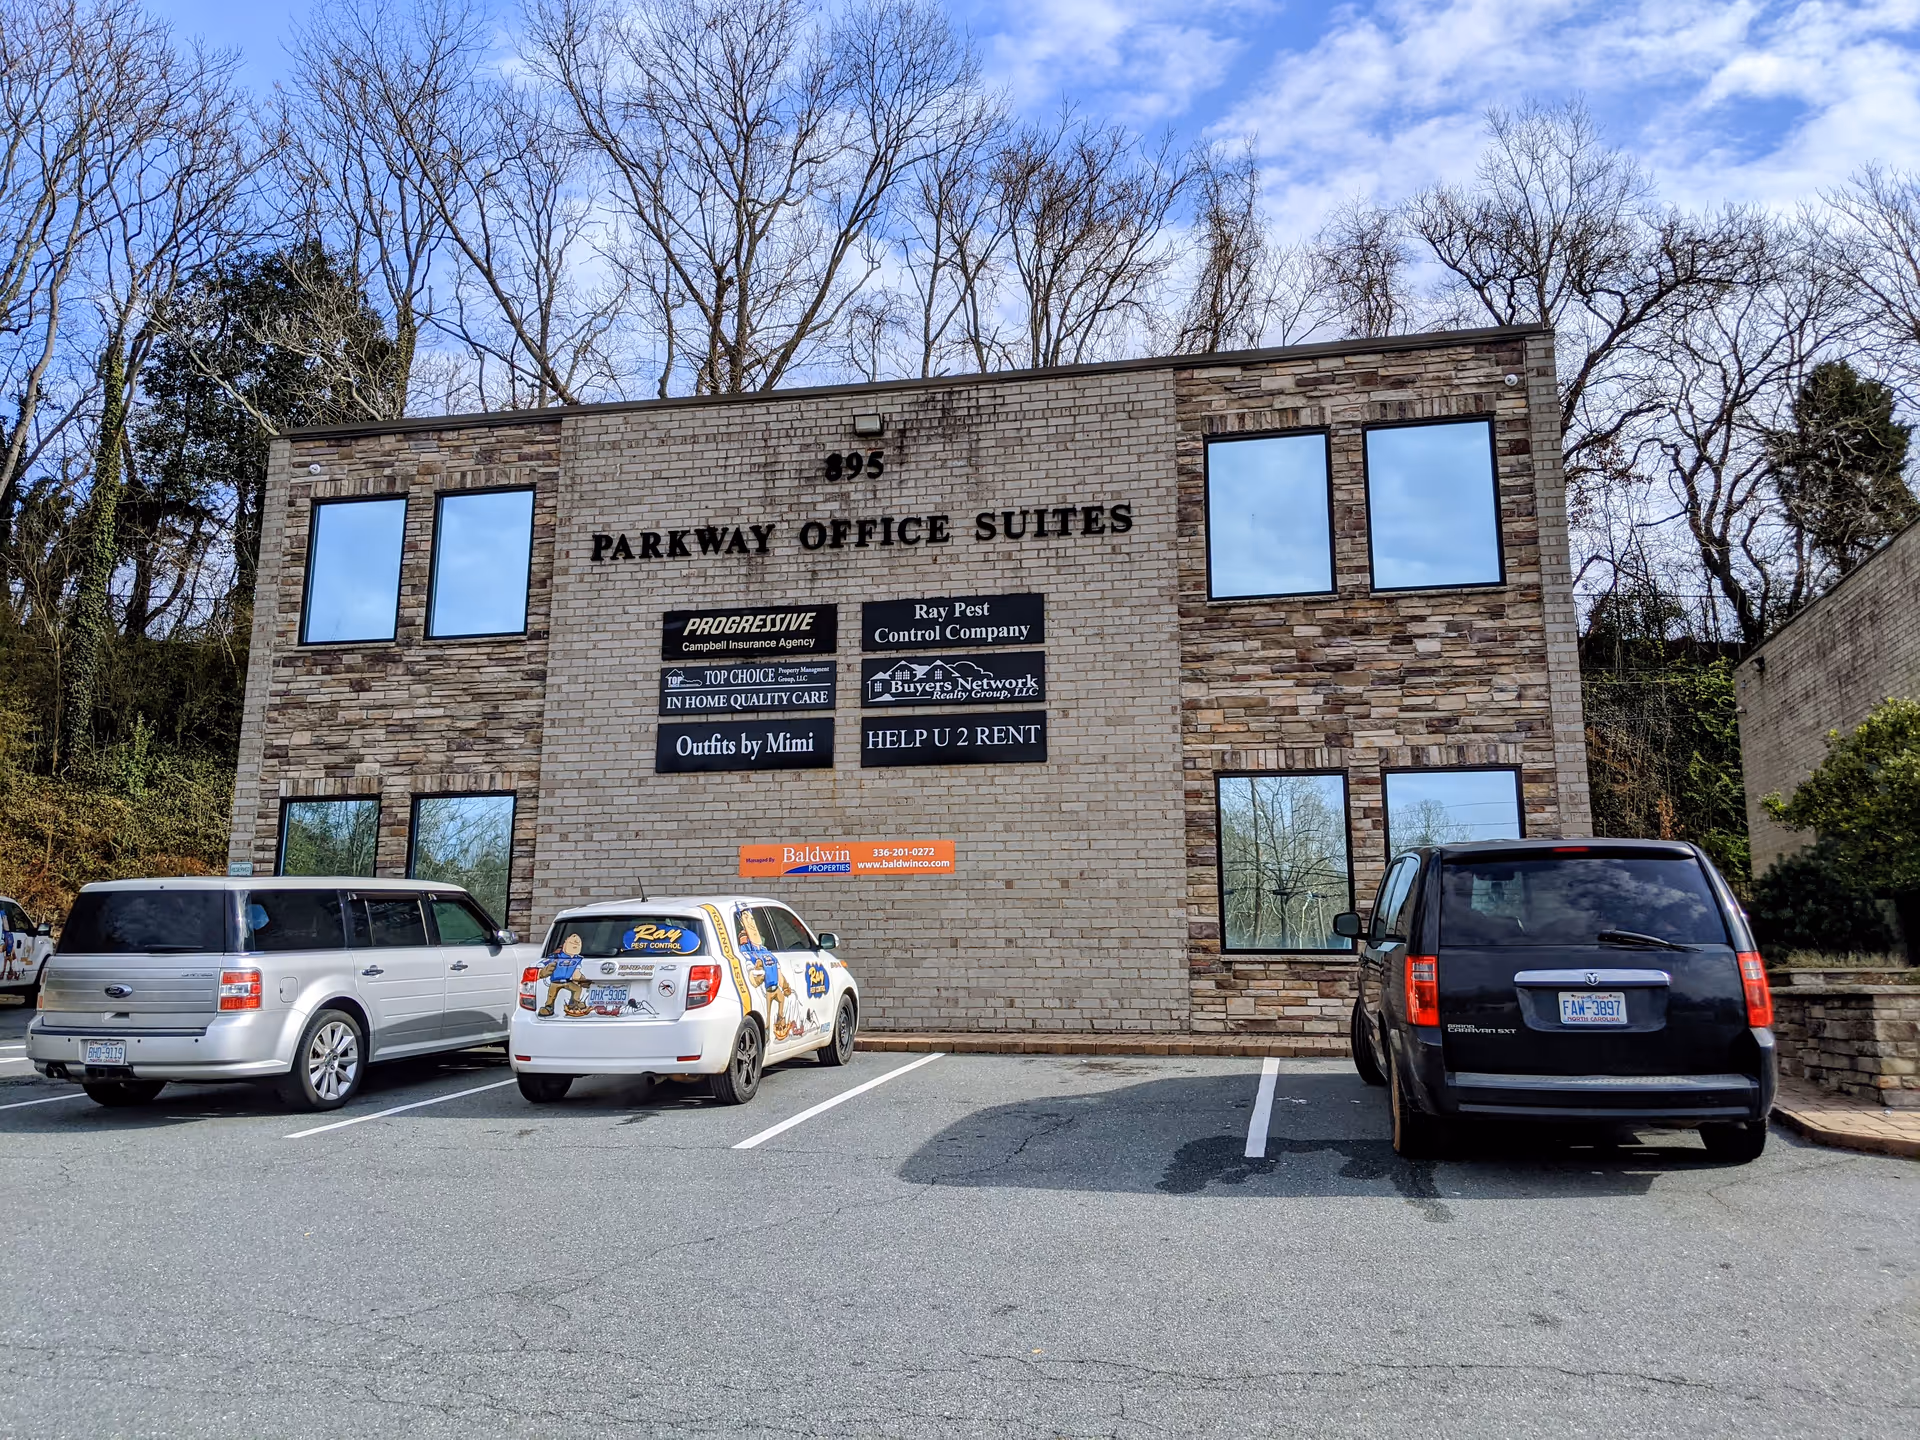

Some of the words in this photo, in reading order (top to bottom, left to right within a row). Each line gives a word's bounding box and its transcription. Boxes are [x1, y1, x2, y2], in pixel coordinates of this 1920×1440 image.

[825, 451, 884, 482] 895
[590, 524, 776, 561] PARKWAY
[799, 515, 951, 550] OFFICE
[975, 502, 1133, 542] SUITES
[914, 603, 949, 622] Ray
[953, 601, 991, 618] Pest
[683, 612, 817, 636] PROGRESSIVE
[874, 626, 941, 643] Control
[945, 624, 1031, 642] Company
[682, 640, 727, 653] Campbell
[729, 638, 776, 650] Insurance
[778, 637, 816, 648] Agency
[667, 676, 682, 684] TOP
[704, 669, 728, 685] TOP
[729, 667, 775, 684] CHOICE
[777, 675, 796, 684] Group,
[796, 674, 808, 682] LLC
[778, 667, 800, 675] Property
[890, 680, 952, 696] Buyers
[956, 673, 1038, 691] Network
[666, 696, 682, 709] IN
[684, 695, 728, 708] HOME
[730, 691, 790, 710] QUALITY
[792, 690, 829, 704] CARE
[932, 690, 969, 701] Realty
[971, 688, 1011, 699] Group,
[1013, 687, 1039, 697] LLC
[676, 733, 736, 757] Outfits
[741, 732, 762, 760] by
[766, 731, 814, 753] Mimi
[867, 729, 928, 749] HELP
[933, 728, 951, 747] U
[956, 727, 969, 746] 2
[975, 725, 1041, 746] RENT
[783, 846, 850, 863] Baldwin
[872, 848, 935, 857] 336-201-0272
[808, 863, 850, 872] PROPERTIES
[857, 859, 950, 869] www.baldwinco.com
[633, 924, 682, 943] Ray
[712, 909, 735, 961] CONTROL
[630, 942, 648, 950] PEST
[649, 942, 682, 950] CONTROL
[733, 964, 746, 994] PEST
[808, 966, 825, 987] Ray
[590, 989, 627, 1001] DHX-9305
[1562, 1000, 1621, 1016] FAW-3897
